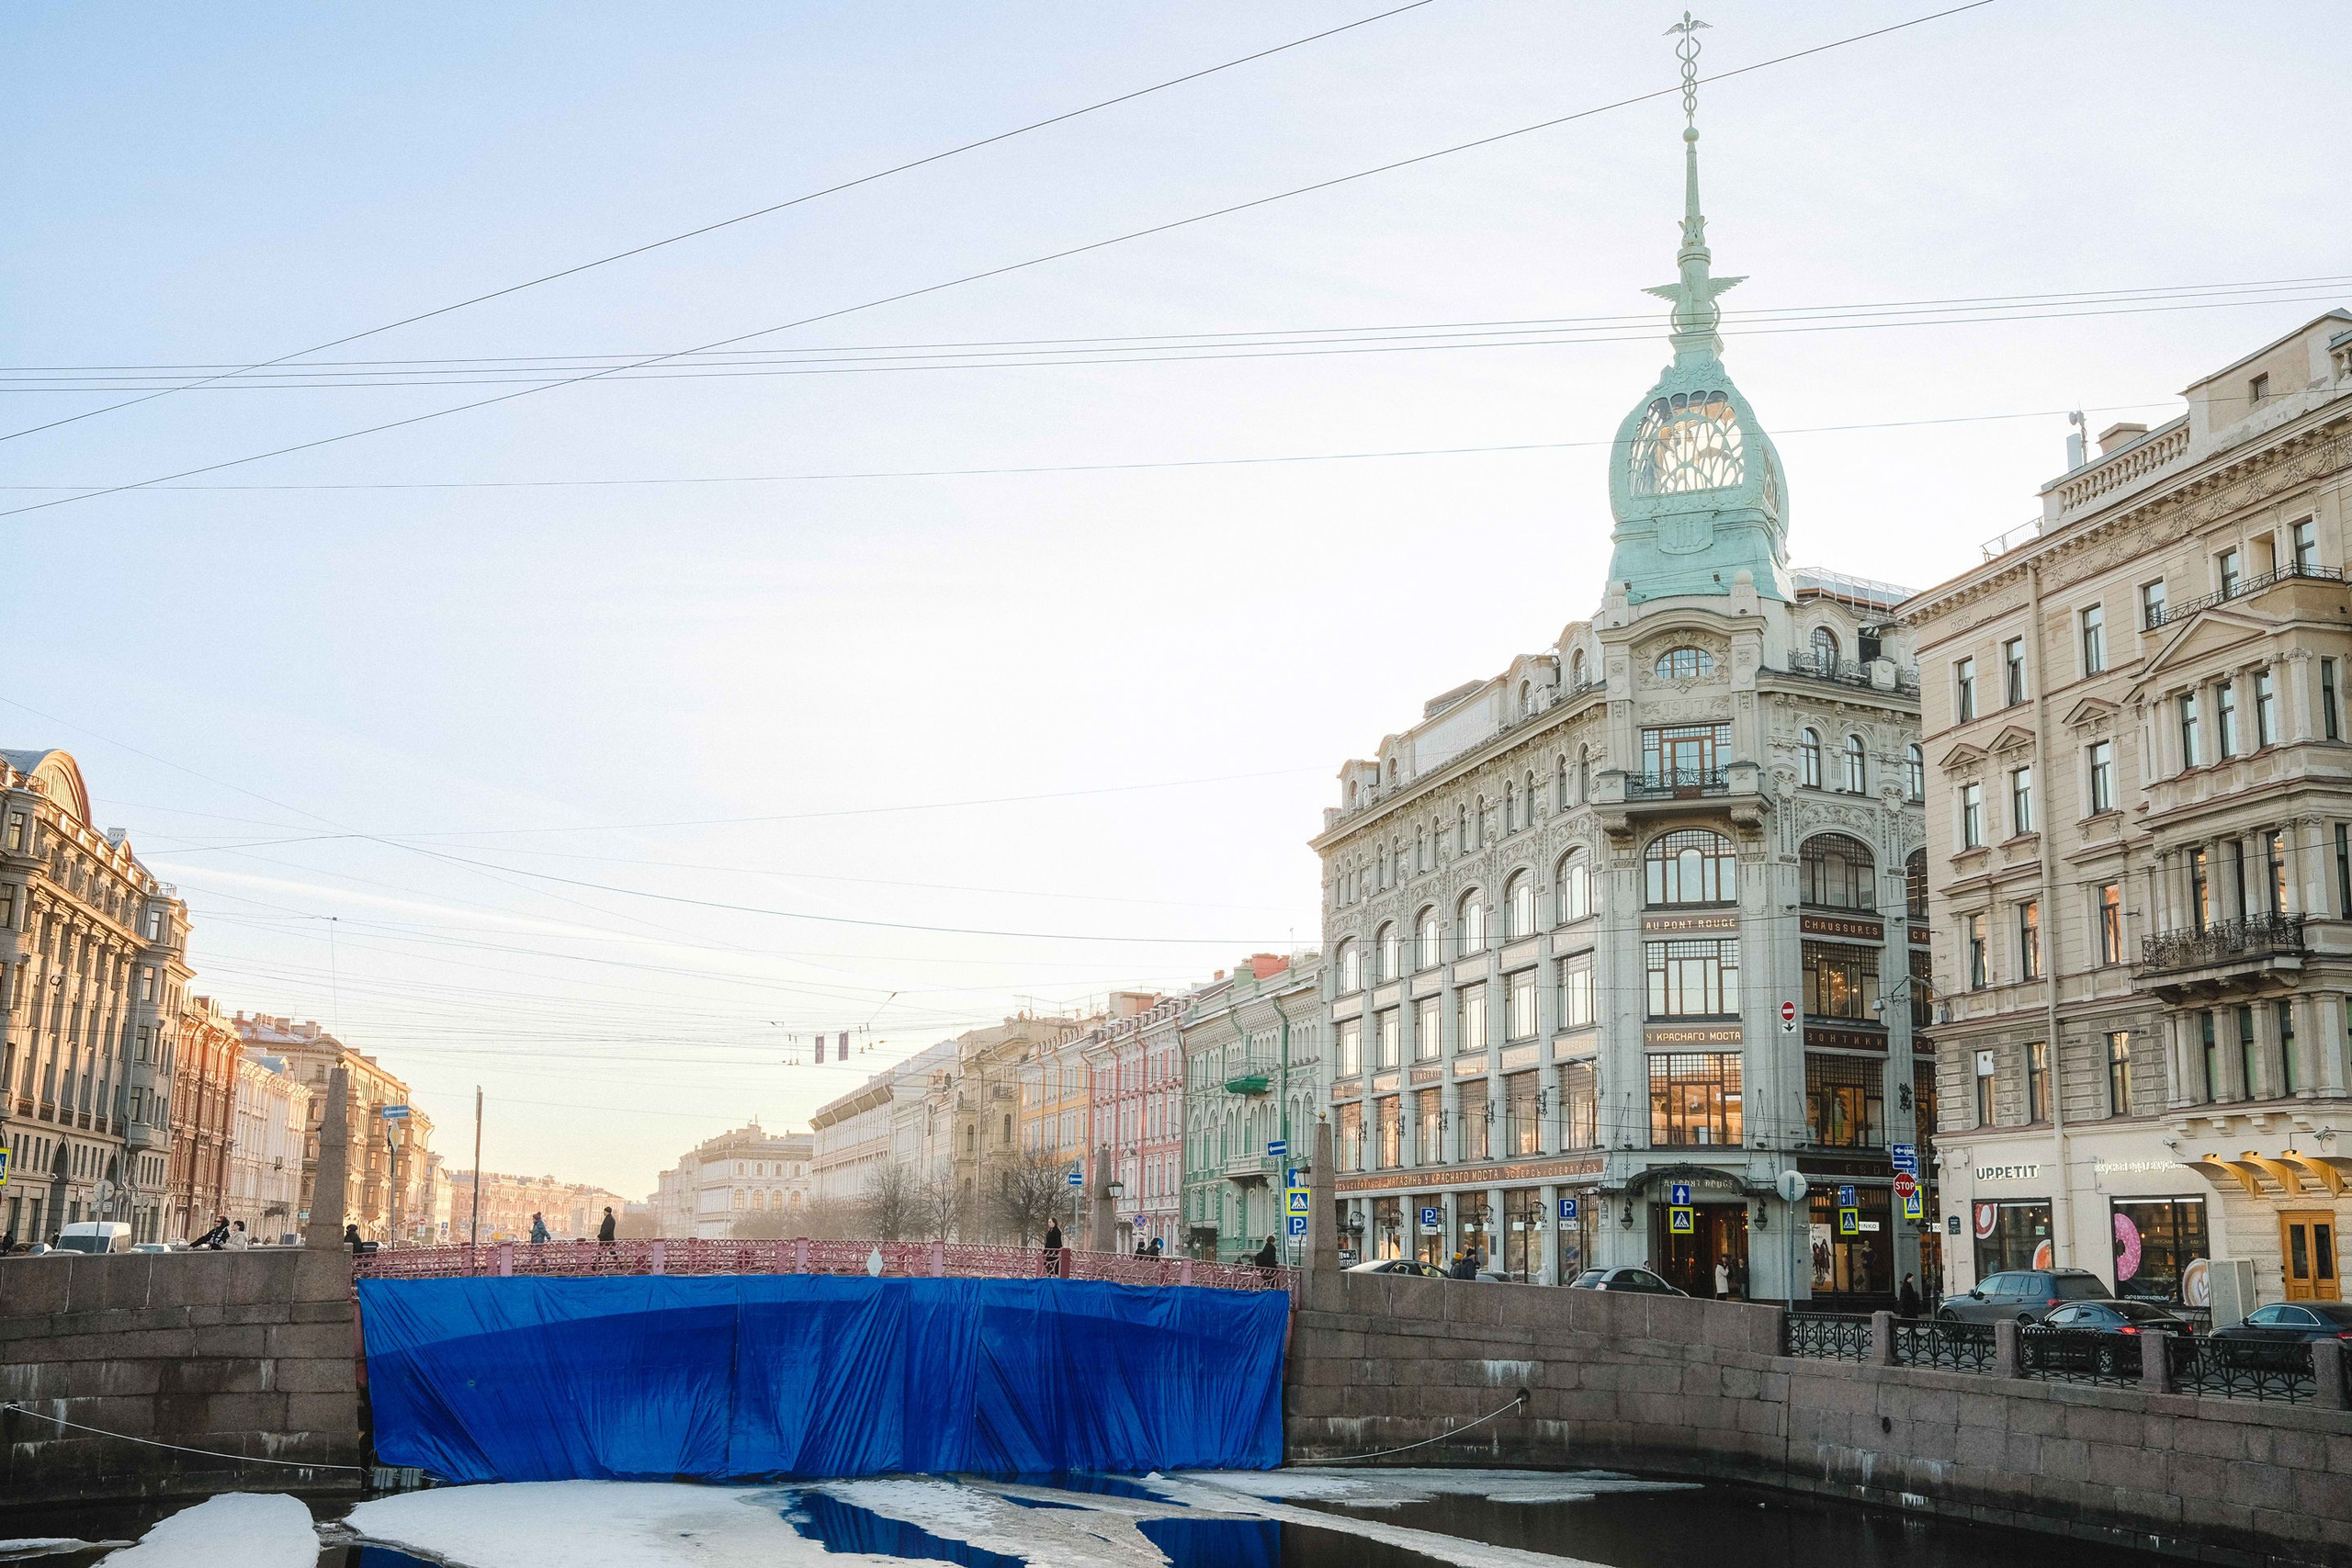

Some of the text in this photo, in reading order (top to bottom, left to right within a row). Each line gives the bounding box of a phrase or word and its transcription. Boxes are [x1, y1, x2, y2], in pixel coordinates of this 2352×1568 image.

[1664, 699, 1704, 716] 1907
[1645, 919, 1736, 930] AU PONT ROUGE
[1804, 919, 1878, 936] CHAUSSURES
[1645, 1031, 1741, 1042] У КРАСНАГО МОСТА
[1808, 1032, 1883, 1046] ЗОНТИКИ
[1387, 1175, 1422, 1188] МАГАЗИНЪ
[1424, 1176, 1429, 1185] У
[1432, 1171, 1469, 1184] КРАСНАГО
[1472, 1168, 1498, 1181] МОСТА
[1975, 1165, 2039, 1180] UPPETIT
[1895, 1181, 1915, 1190] STOP
